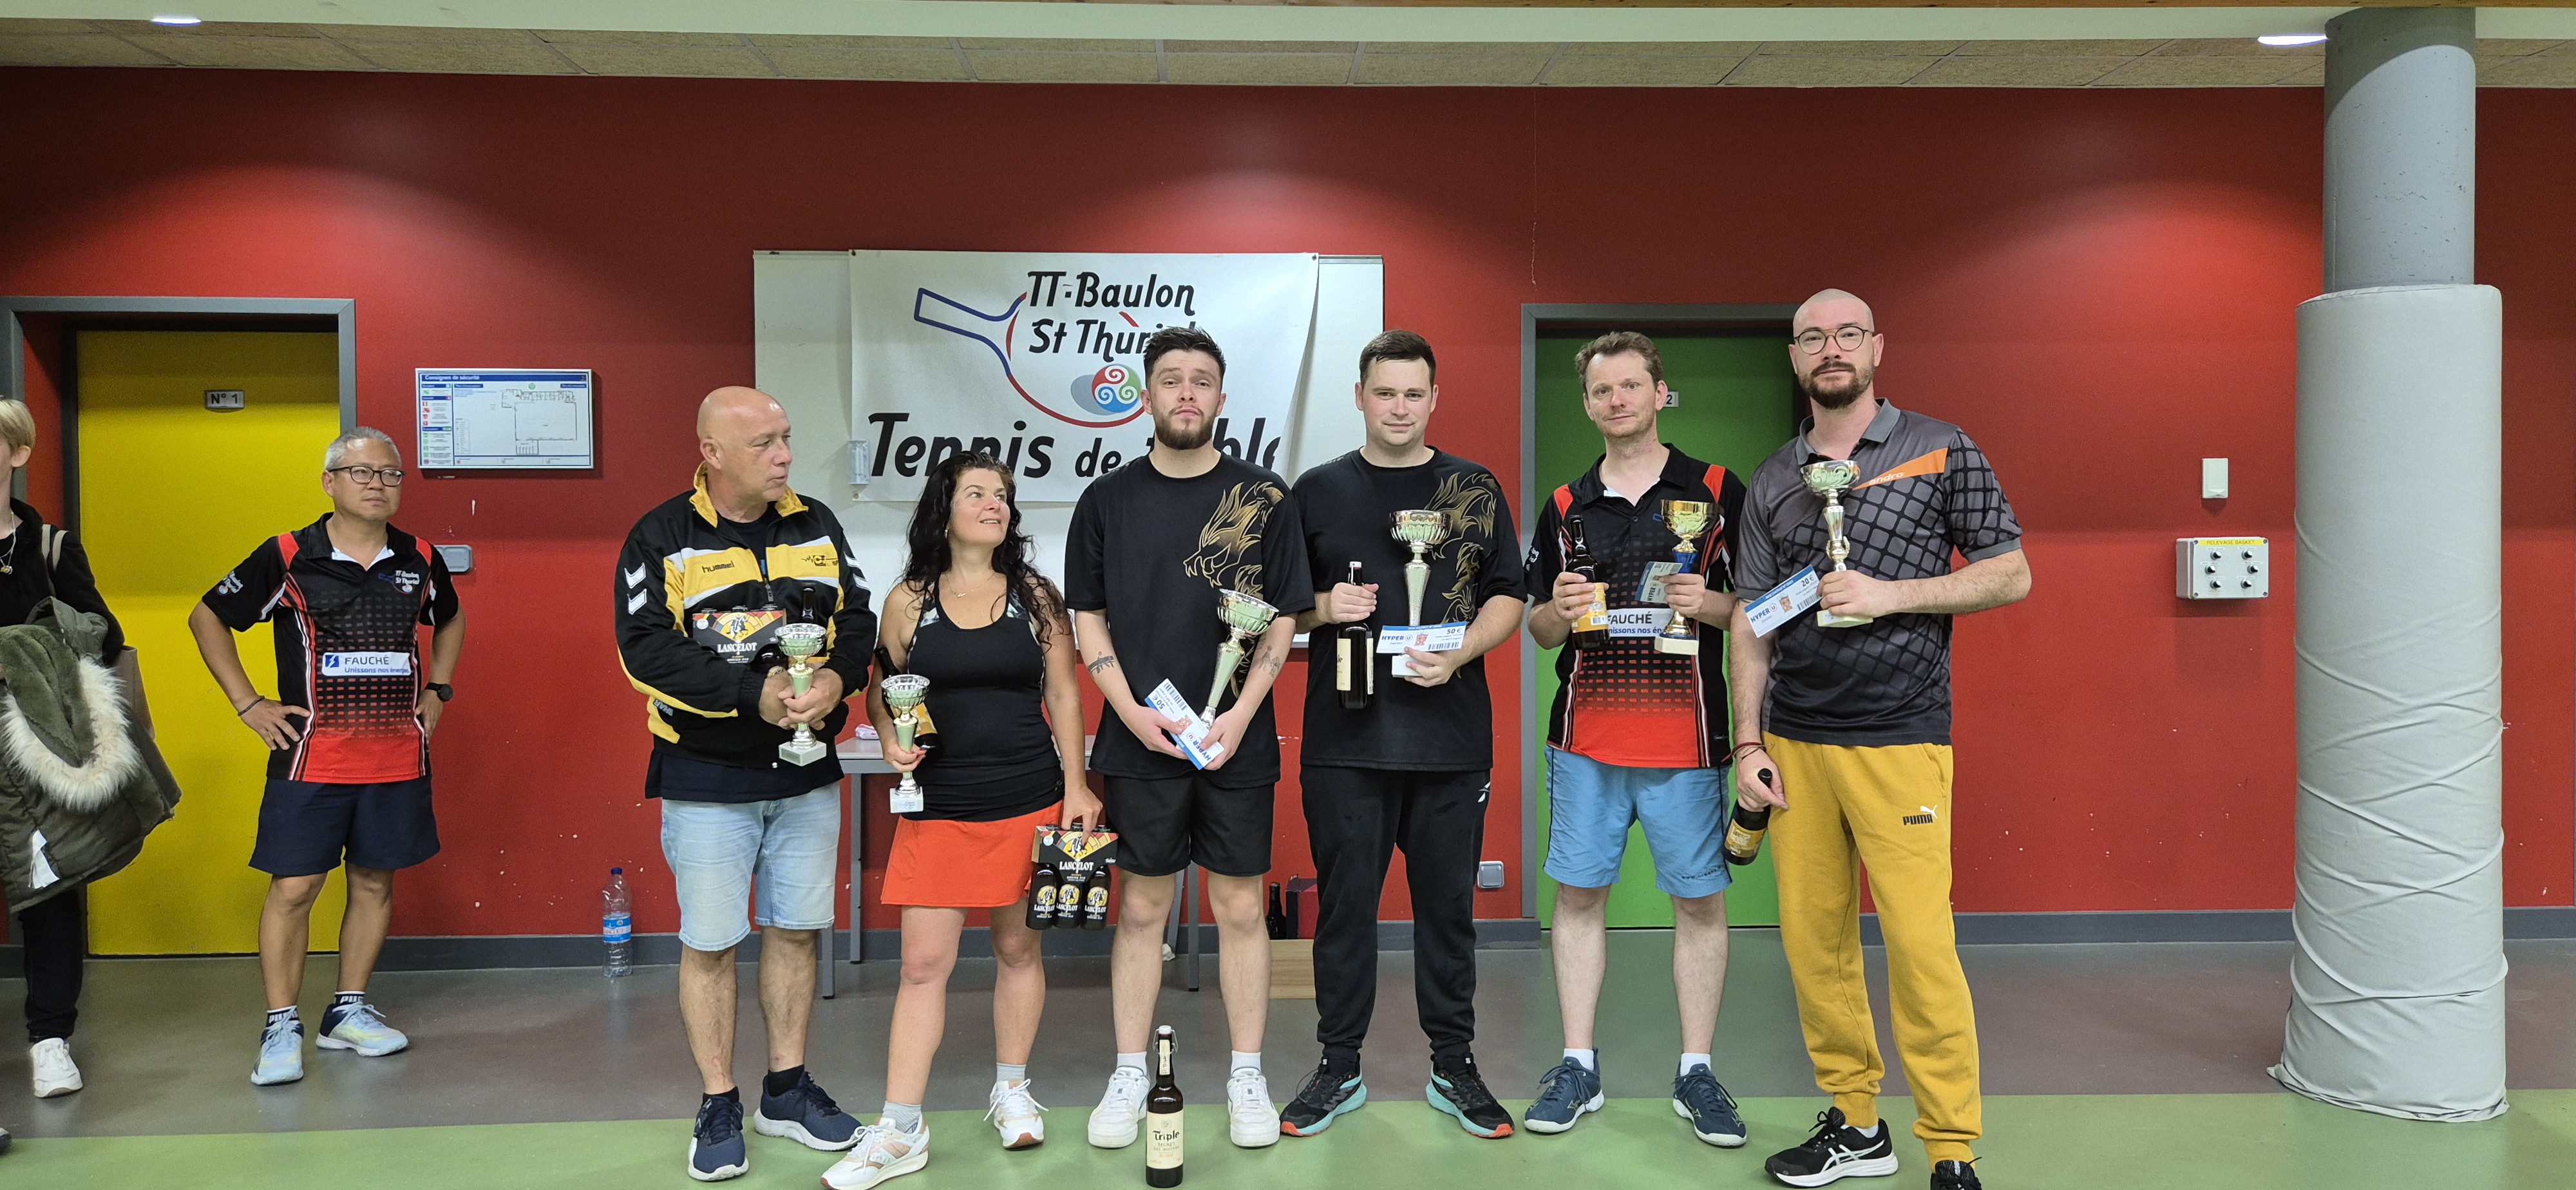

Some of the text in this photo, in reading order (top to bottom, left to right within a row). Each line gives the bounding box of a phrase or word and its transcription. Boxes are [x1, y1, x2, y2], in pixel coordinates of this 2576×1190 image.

[1029, 319, 1068, 354] St
[211, 393, 238, 404] N° 1
[1666, 394, 1672, 405] 2
[1075, 438, 1122, 477] de
[1869, 472, 1905, 485] andro
[702, 561, 735, 573] hummel
[1801, 578, 1810, 587] 20
[1750, 608, 1770, 623] HYPER
[717, 642, 757, 653] LANCELOT
[345, 655, 389, 665] FAUCHÉ
[1157, 699, 1166, 709] 50
[1902, 814, 1933, 826] PUMA
[1059, 861, 1094, 871] LANCELOT
[1056, 902, 1078, 912] LANCELOT
[1152, 1129, 1180, 1142] Triple
